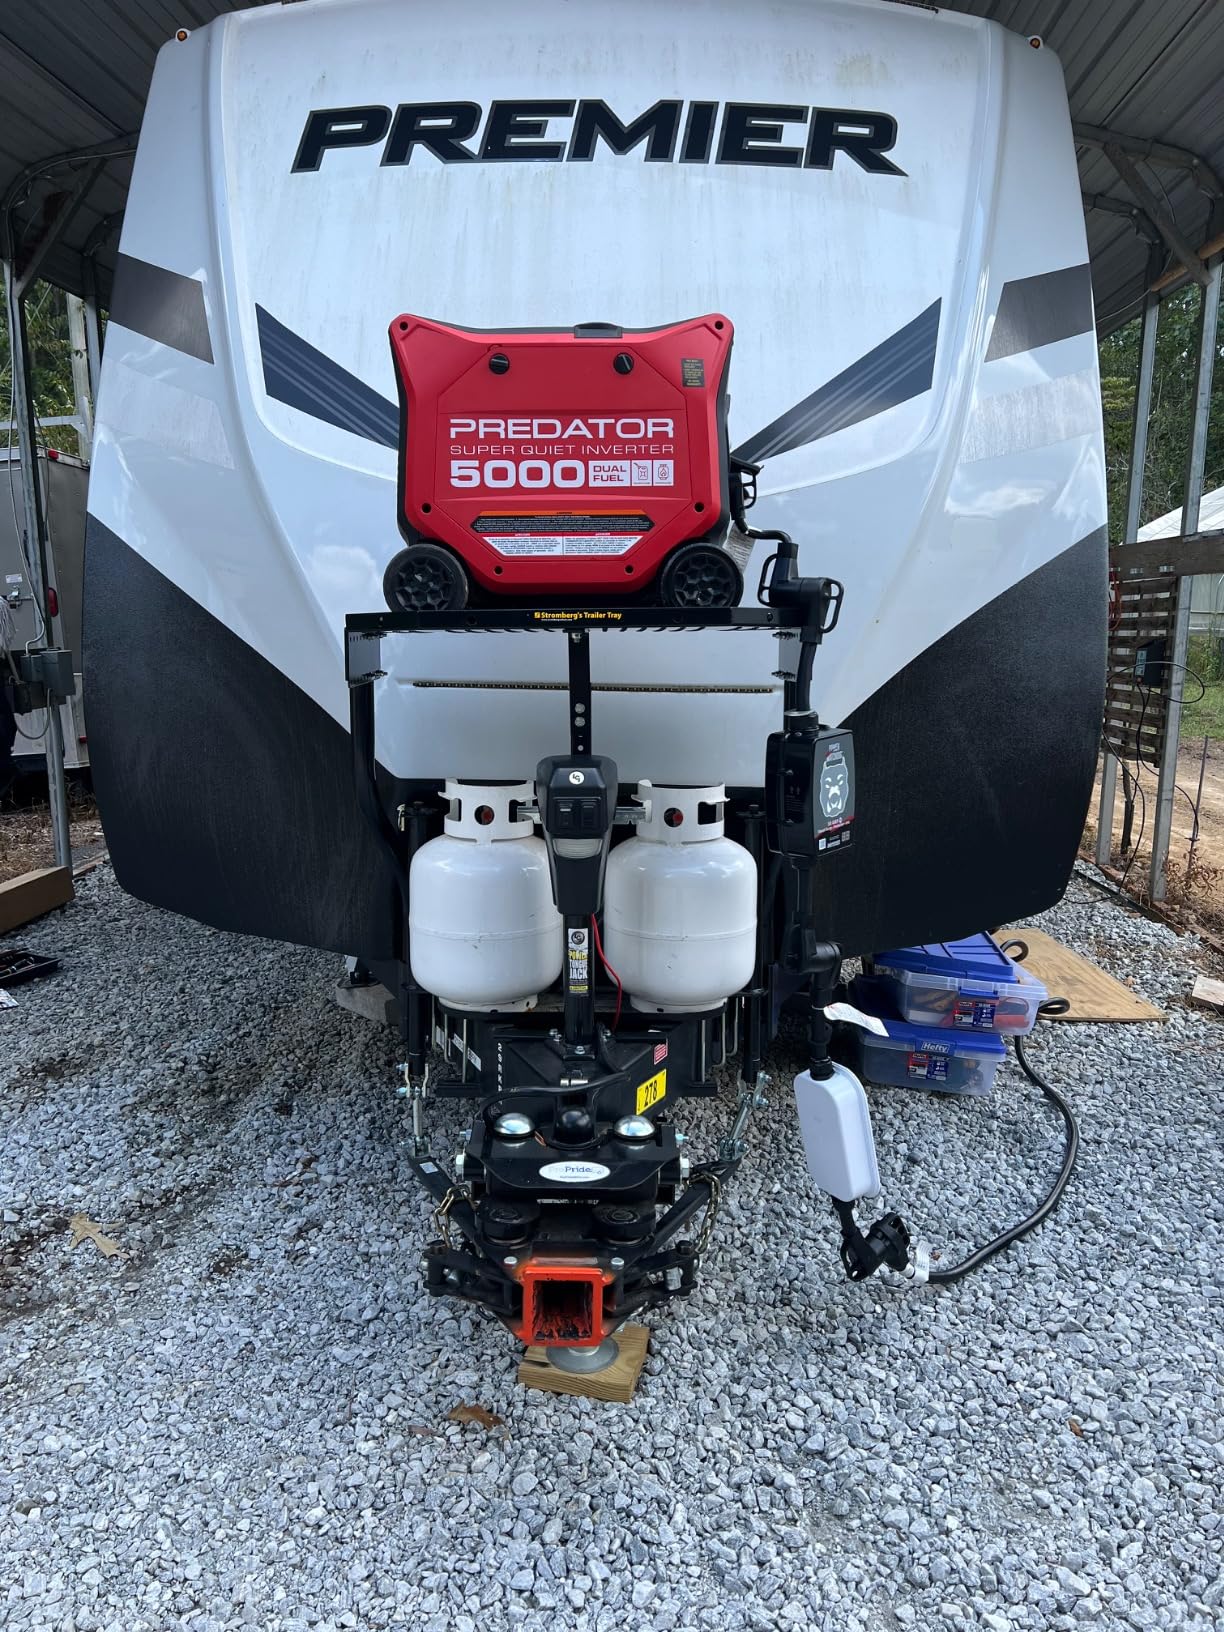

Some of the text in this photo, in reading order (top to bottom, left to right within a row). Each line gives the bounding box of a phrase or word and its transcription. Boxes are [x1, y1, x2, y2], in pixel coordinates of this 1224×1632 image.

[291, 100, 908, 176] PREMIER
[450, 418, 674, 439] PREDATOR
[450, 444, 674, 455] SUPER QUIET INVERTER
[450, 459, 585, 488] 5000
[593, 465, 627, 473] DUAL
[593, 474, 625, 482] FUEL
[541, 611, 622, 620] Stromberg's Trailer Tray
[569, 968, 588, 979] JACK
[923, 1042, 947, 1053] Hefty
[644, 1080, 658, 1107] 278
